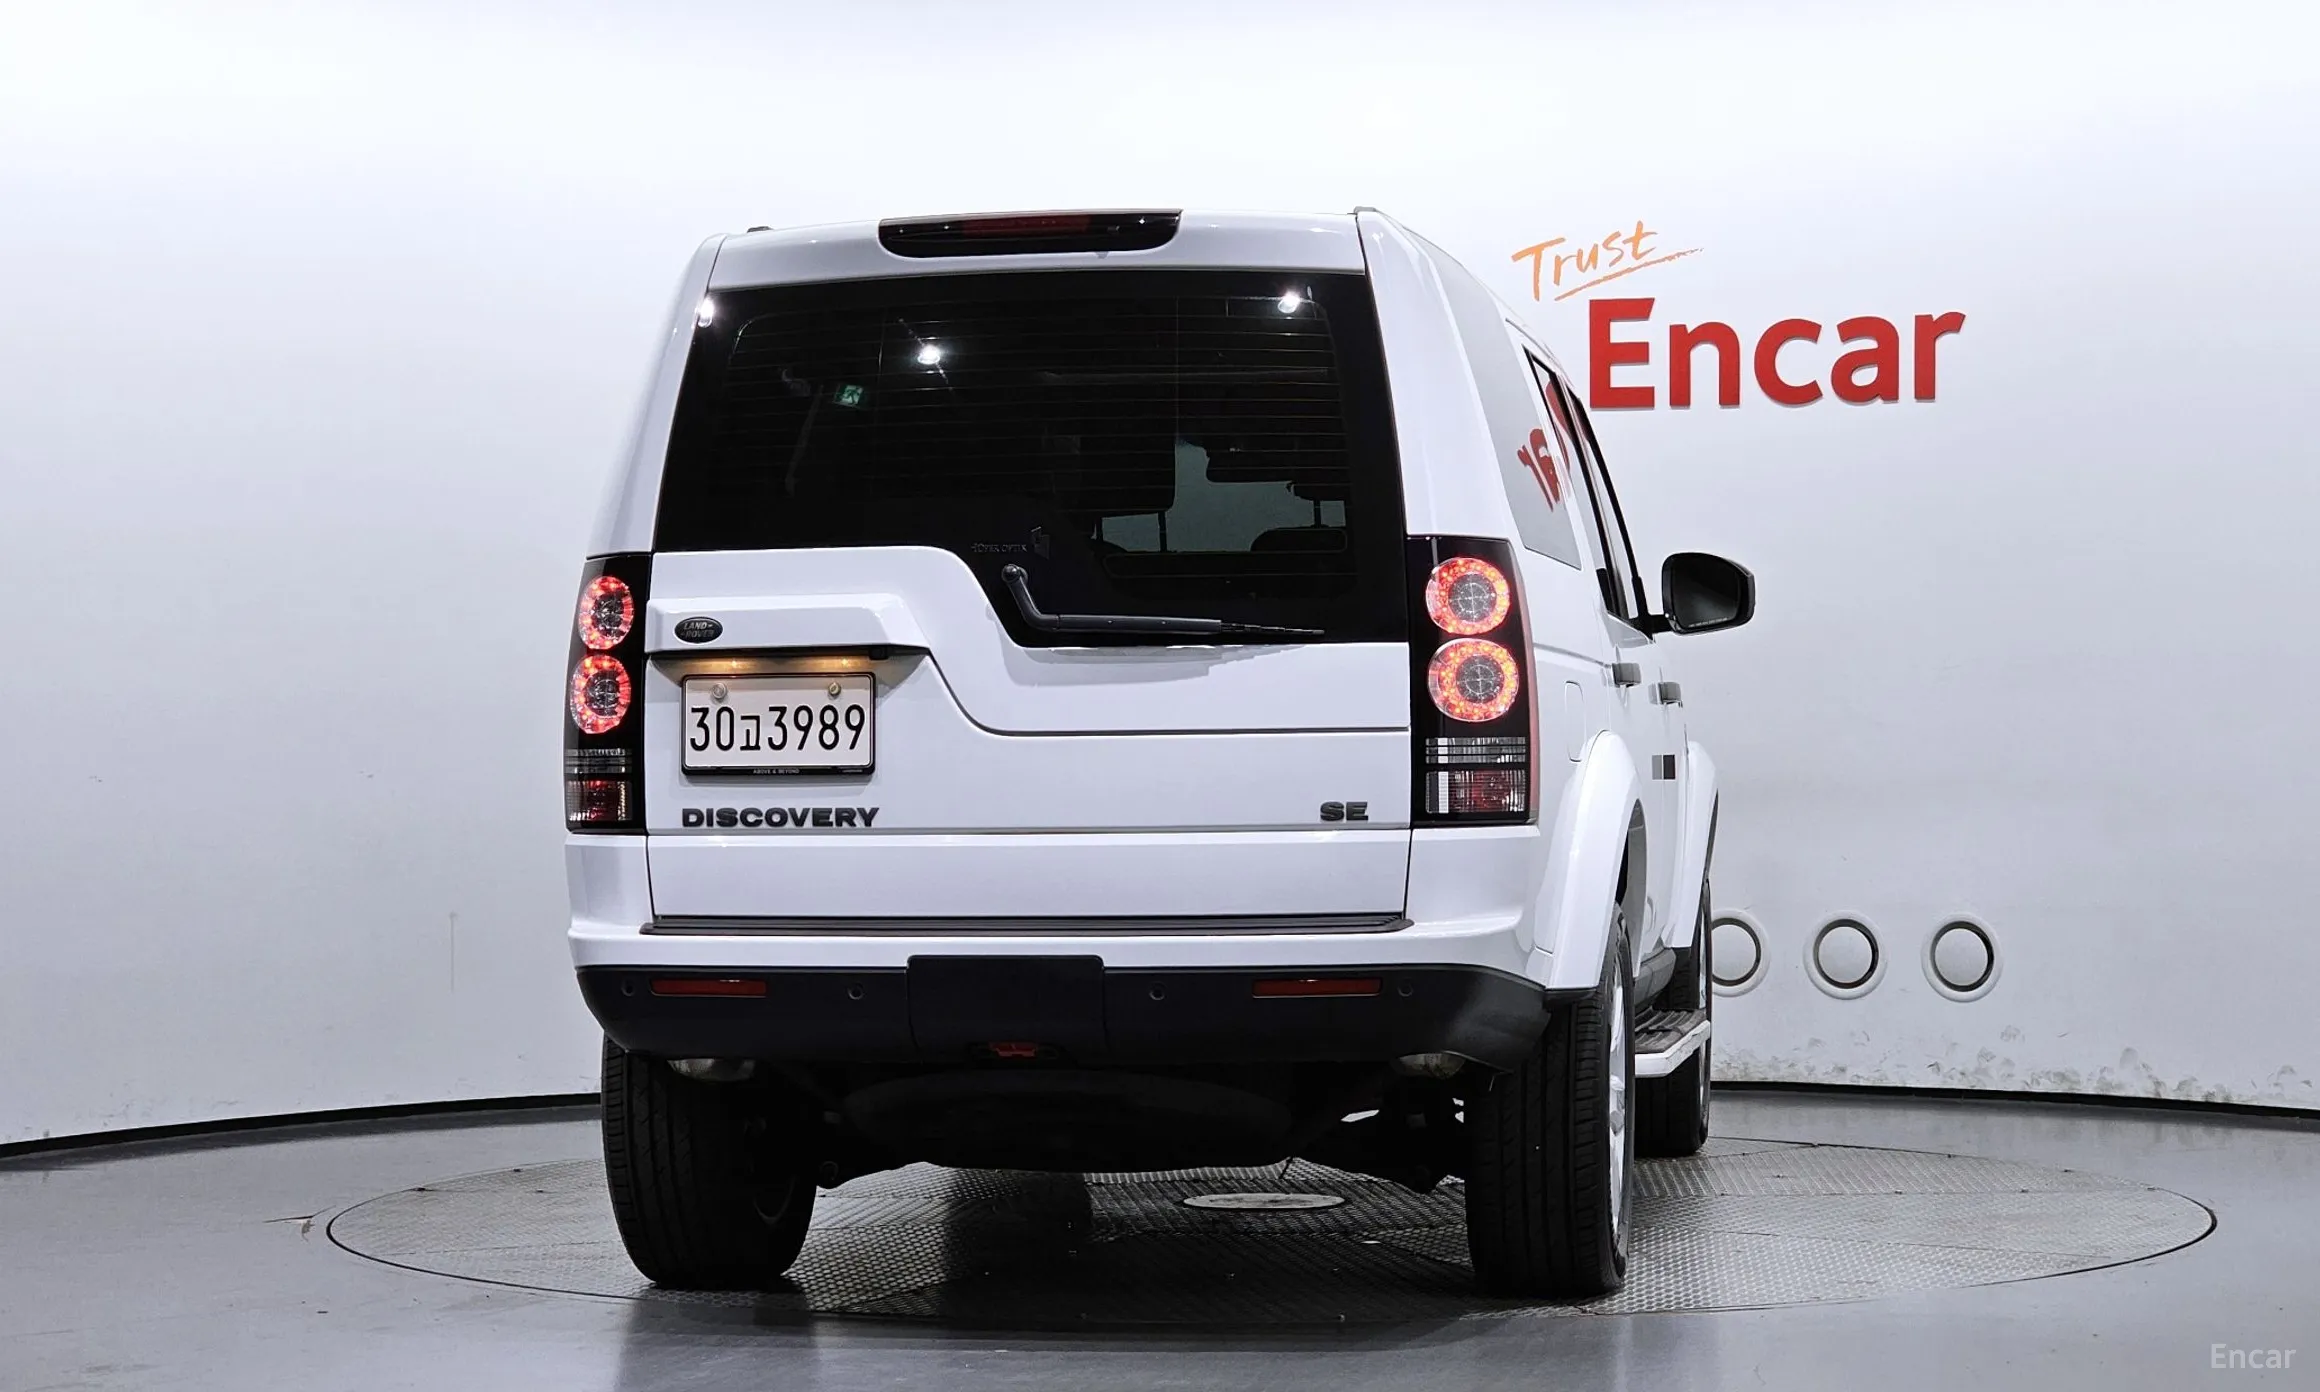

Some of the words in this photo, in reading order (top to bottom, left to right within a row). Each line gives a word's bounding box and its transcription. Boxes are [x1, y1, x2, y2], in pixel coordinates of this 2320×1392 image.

[1511, 219, 1659, 302] Trust
[1588, 297, 1967, 410] Encar
[689, 703, 866, 752] 30고3989
[682, 807, 880, 828] DISCOVERY
[1320, 801, 1369, 821] SE
